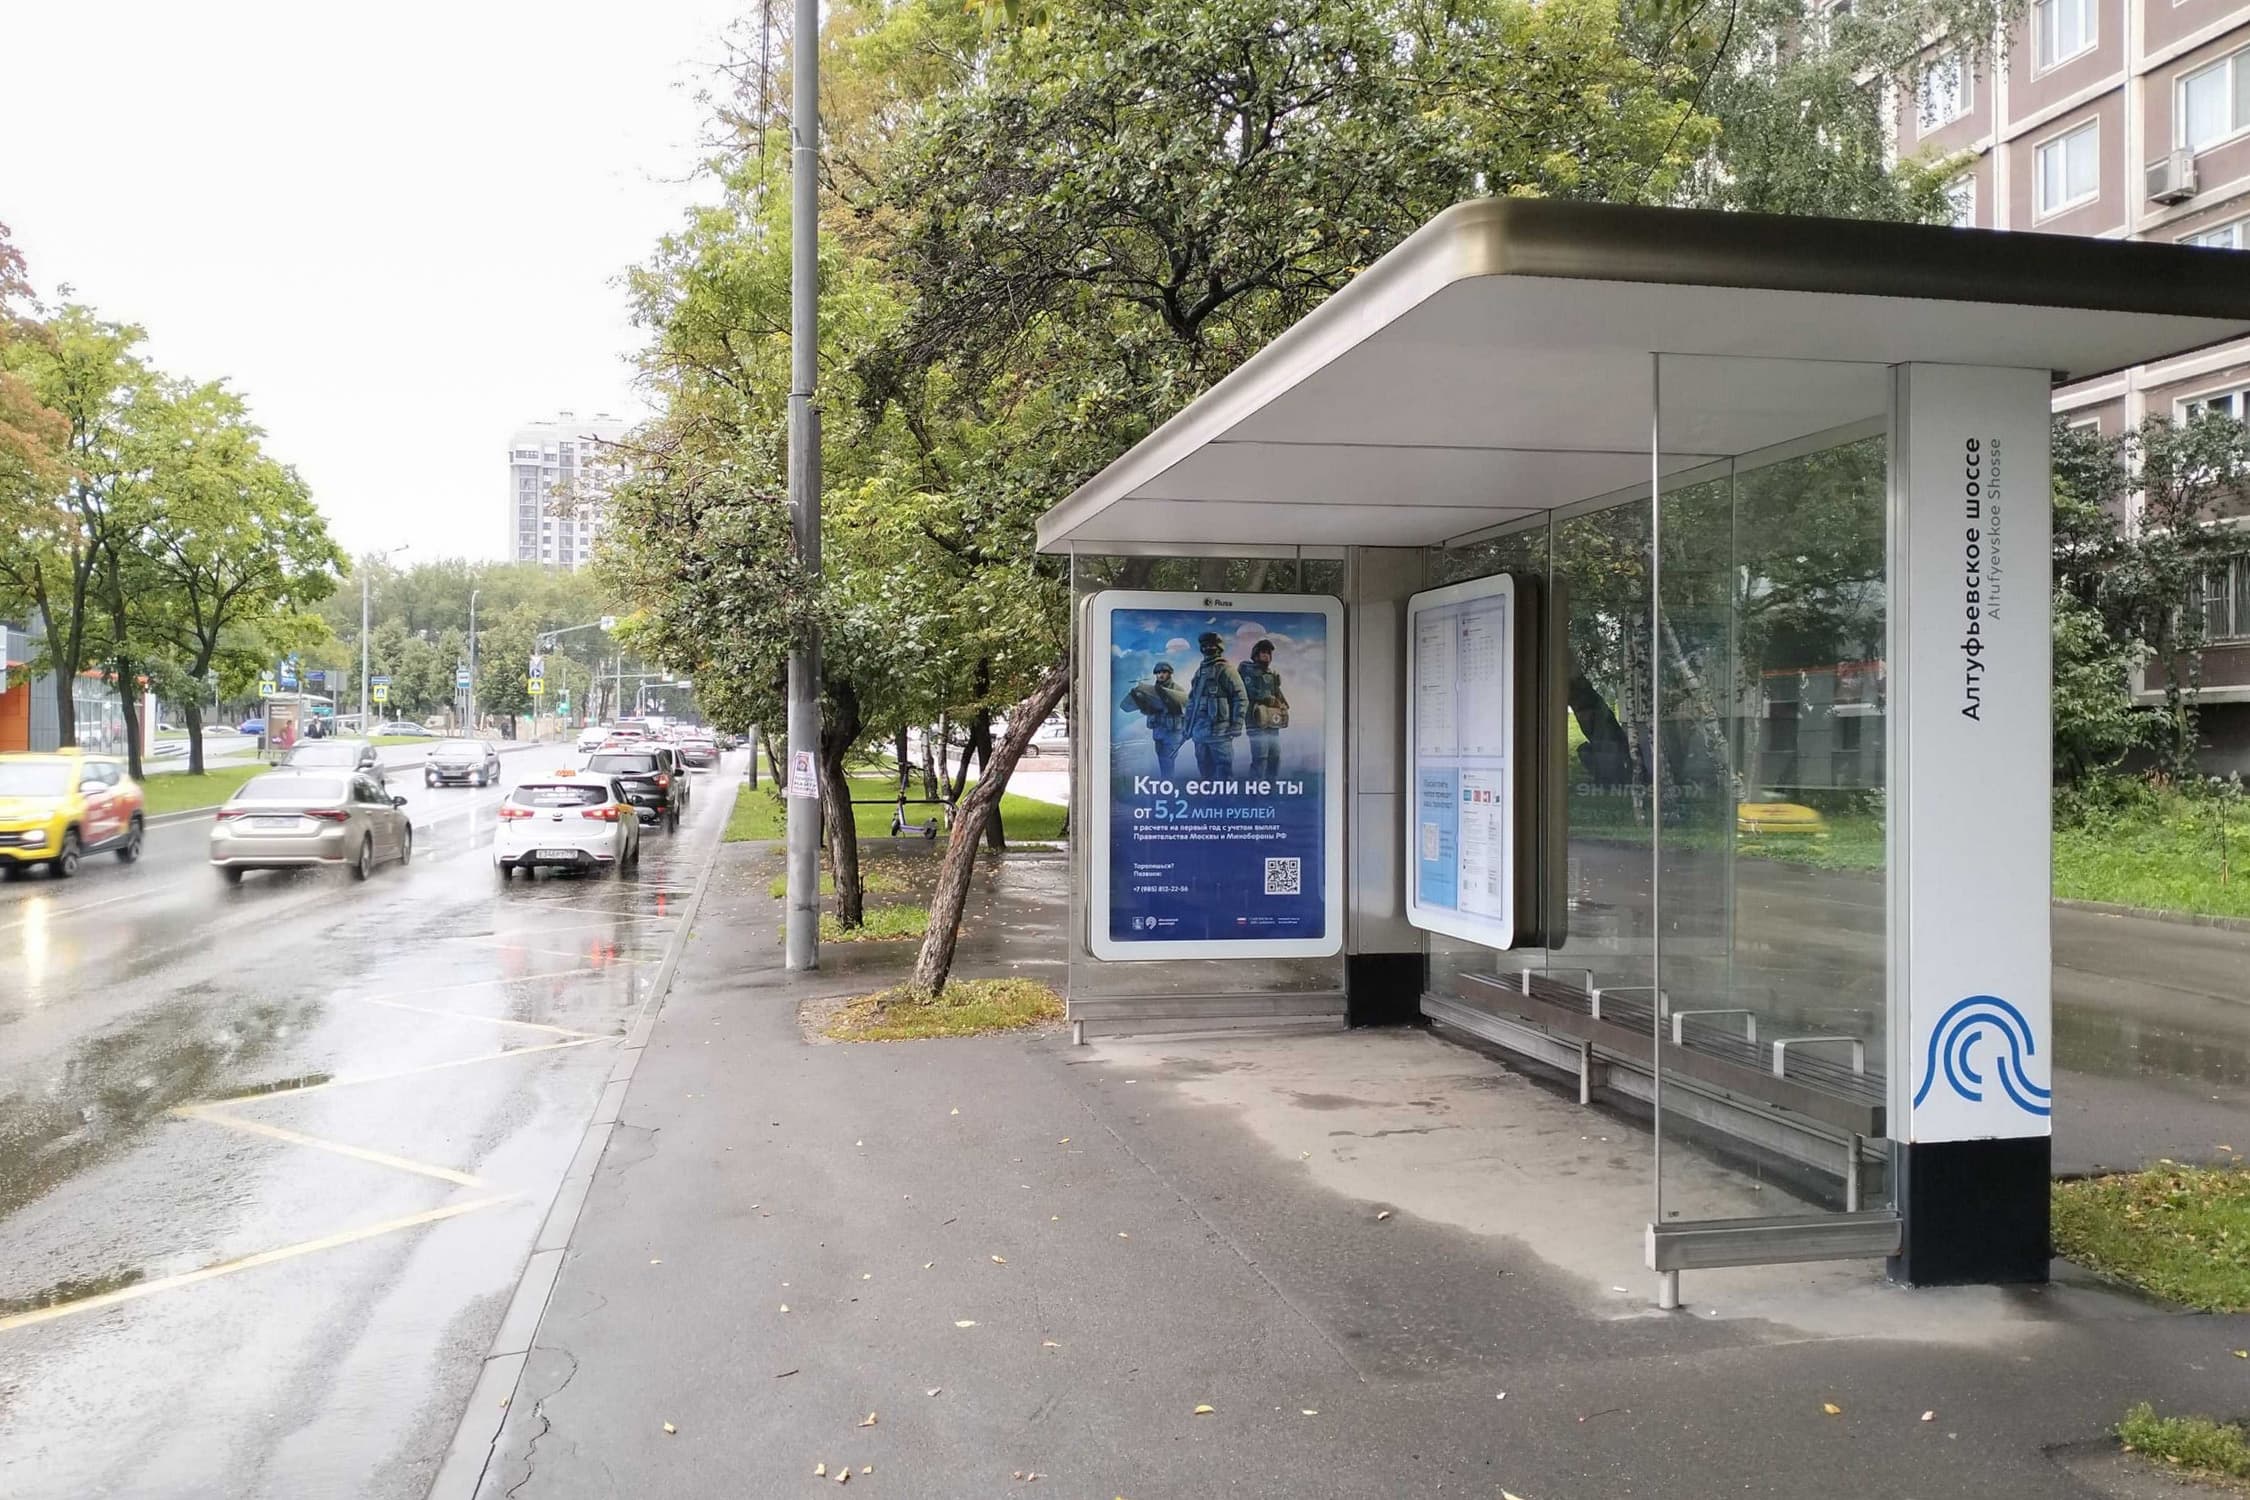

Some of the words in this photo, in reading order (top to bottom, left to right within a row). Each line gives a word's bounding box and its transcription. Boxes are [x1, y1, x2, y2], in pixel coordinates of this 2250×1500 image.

[1966, 437, 1980, 519] шоссе
[1987, 438, 2001, 500] Shosse
[1987, 505, 2003, 620] Altufyevskoe
[1960, 527, 1985, 721] Алтуфьевское
[1134, 775, 1180, 798] Кто,
[1186, 780, 1239, 795] если
[1245, 780, 1271, 795] не
[1275, 780, 1303, 795] ты
[1134, 807, 1152, 819] от
[1155, 799, 1188, 822] 5,2
[1226, 806, 1275, 819] РУБЛЕЙ
[1180, 824, 1207, 832] первый
[1133, 833, 1188, 841] Правительства
[1227, 832, 1274, 840] Минобороны
